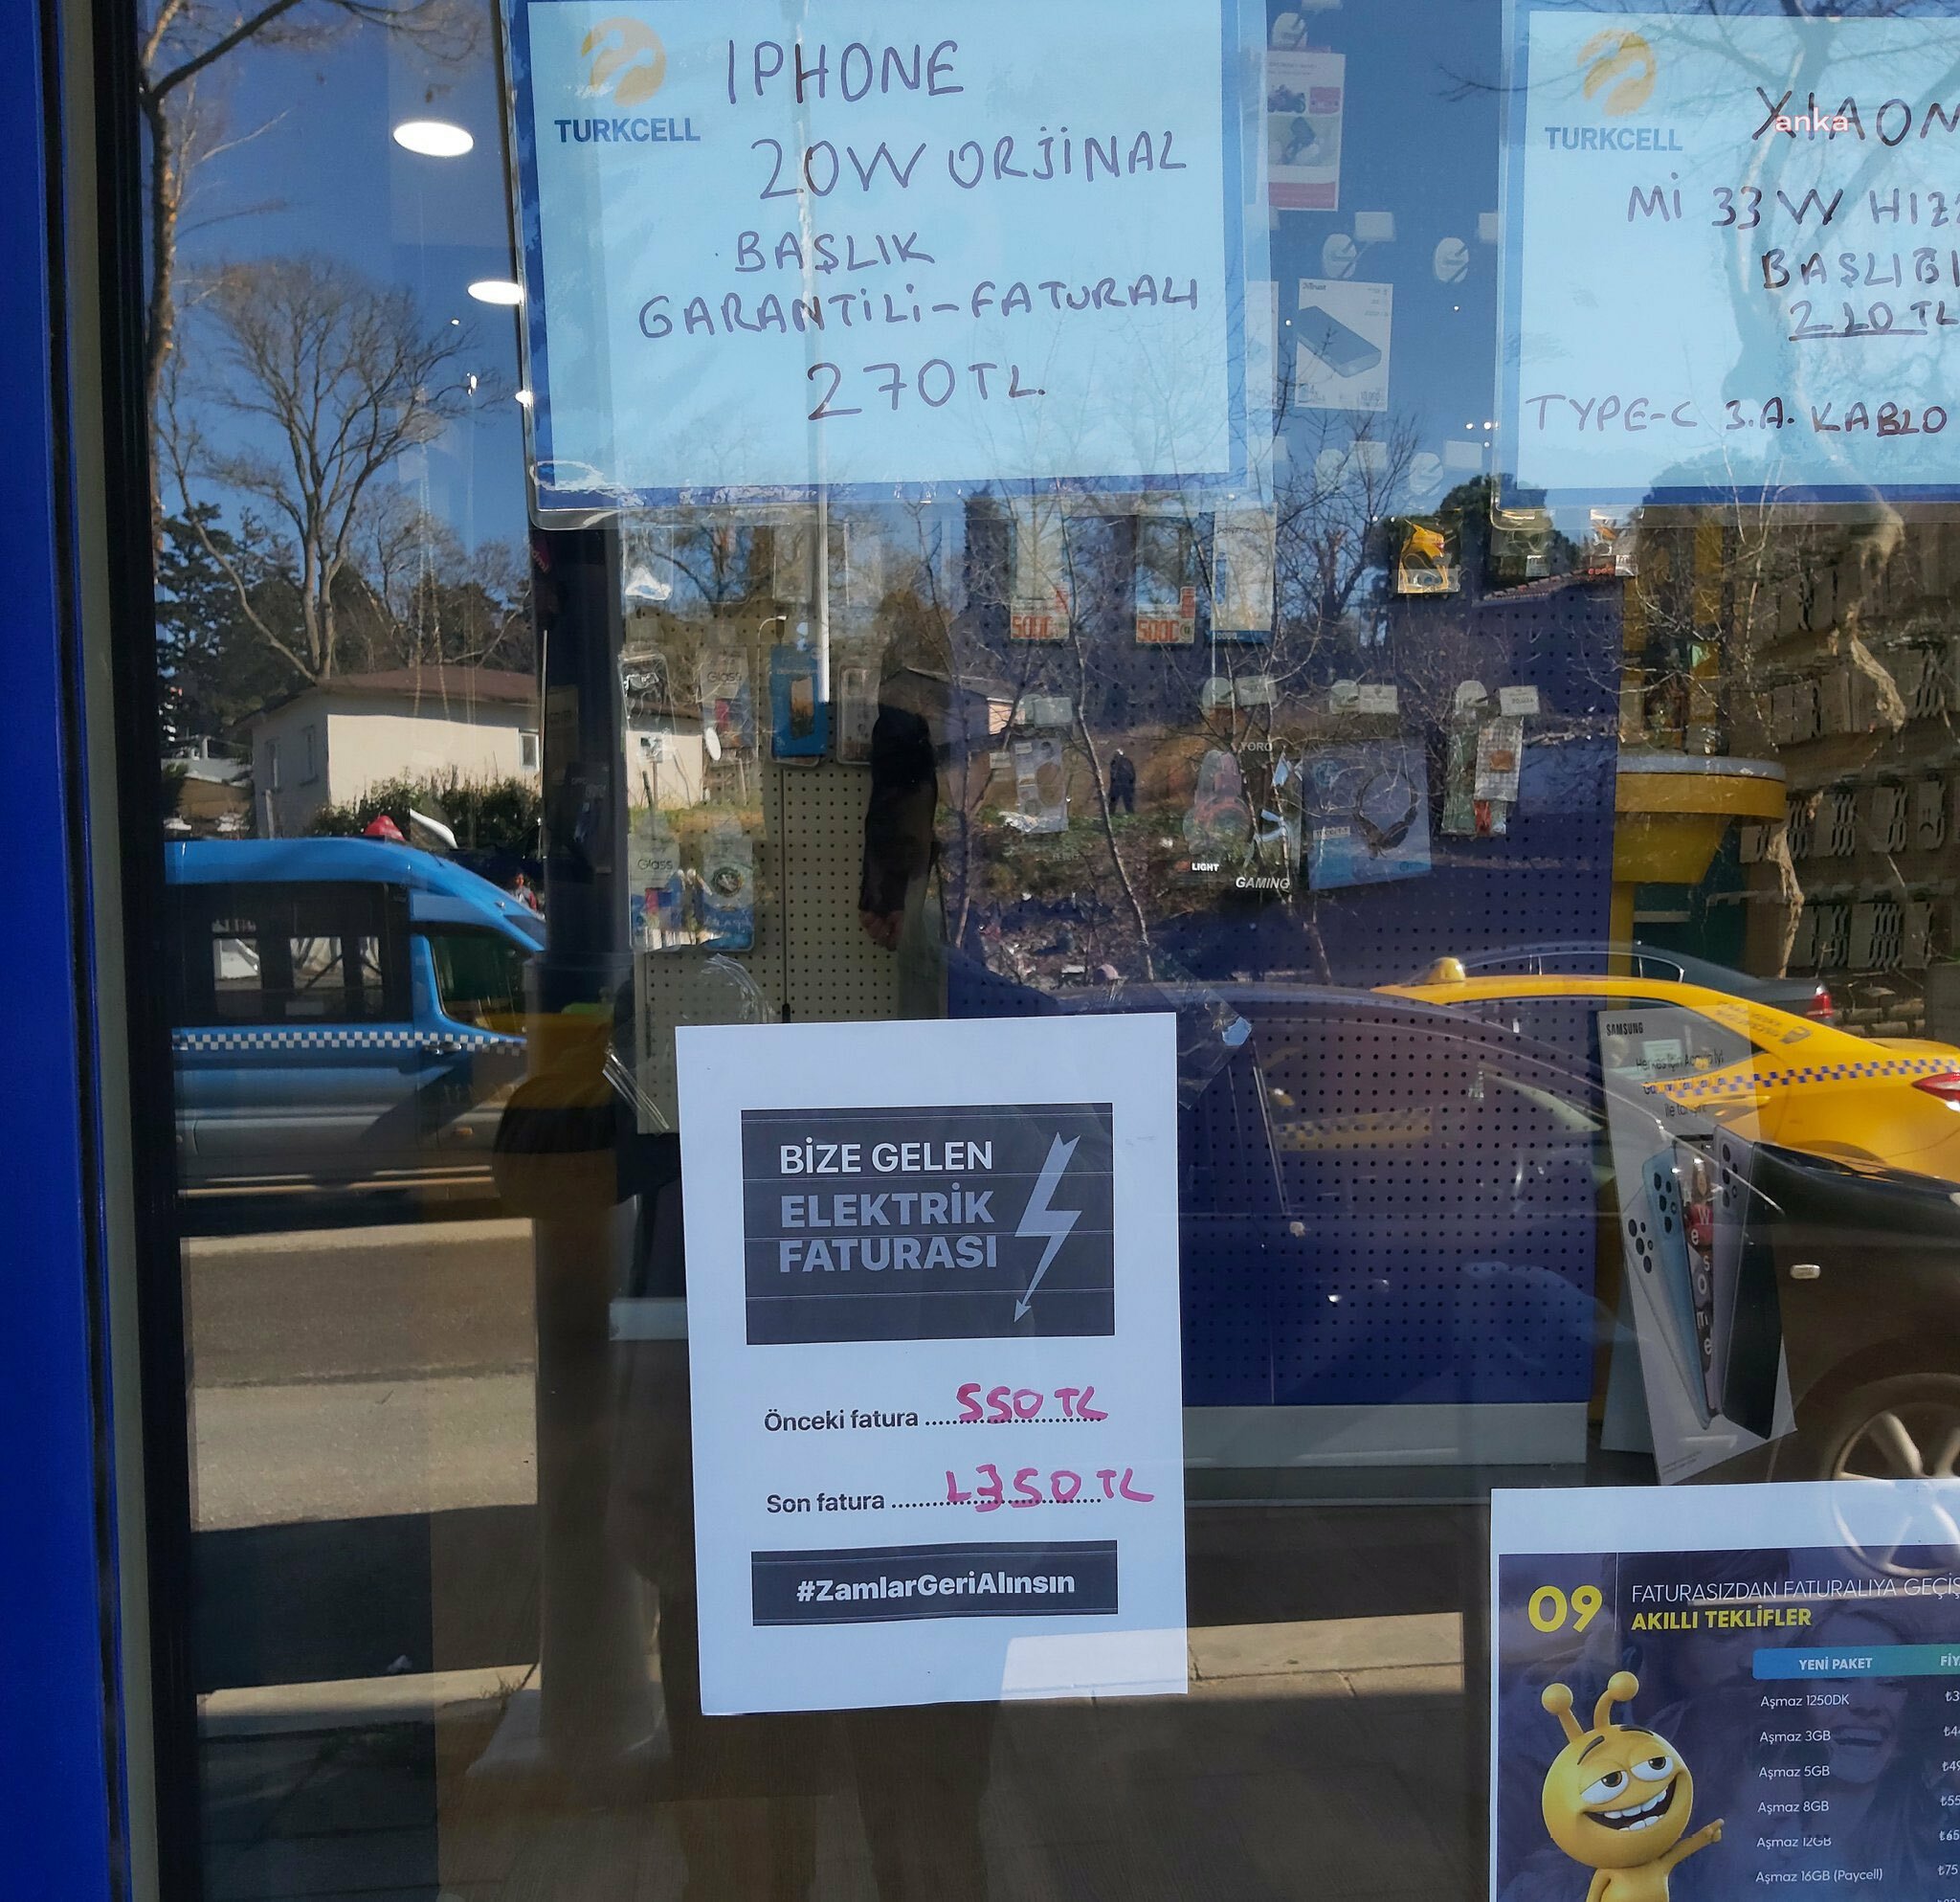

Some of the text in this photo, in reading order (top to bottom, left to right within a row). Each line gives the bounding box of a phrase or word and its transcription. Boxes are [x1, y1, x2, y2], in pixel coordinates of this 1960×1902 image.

[728, 39, 964, 104] IPHONE
[554, 118, 701, 143] TURKCELL
[1545, 127, 1682, 151] TURKCELL
[735, 230, 935, 275] BAŞLIK
[1526, 393, 1698, 432] TYPE-C
[1192, 862, 1220, 872] LIGHT
[1236, 877, 1290, 889] GAMING
[1606, 1022, 1643, 1036] SAMSUNG
[779, 1136, 993, 1175] BİZE GELEN
[780, 1182, 995, 1228] ELEKTRİK
[778, 1235, 997, 1273] FATURASI
[1054, 1385, 1108, 1421] TL
[764, 1408, 919, 1432] Önceki fatura
[1096, 1467, 1154, 1502] TL
[766, 1490, 885, 1513] Son fatura
[796, 1570, 1076, 1603] #ZamlarGeriAlınsın
[1632, 1573, 1960, 1602] FATURASIZDAN FATURALIYA GEÇİŞ
[1528, 1584, 1603, 1633] 09
[1631, 1604, 1812, 1631] AKILLI TEKLİFLER
[1798, 1653, 1960, 1671] YENİ PAKET FİY
[1760, 1696, 1803, 1710] Aşmaz
[1806, 1694, 1850, 1707] 1250DK
[1759, 1732, 1801, 1745] Aşmaz
[1805, 1730, 1831, 1742] 3GB
[1758, 1767, 1800, 1780] Aşmaz
[1804, 1765, 1831, 1778] 5GB
[1757, 1802, 1799, 1816] Aşmaz
[1803, 1801, 1829, 1813] 8GB
[1756, 1837, 1798, 1850] Aşmaz
[1802, 1836, 1832, 1847] 12GB
[1755, 1870, 1797, 1885] Aşmaz
[1800, 1869, 1831, 1882] 16GB
[1833, 1868, 1883, 1883] (Paycell)
